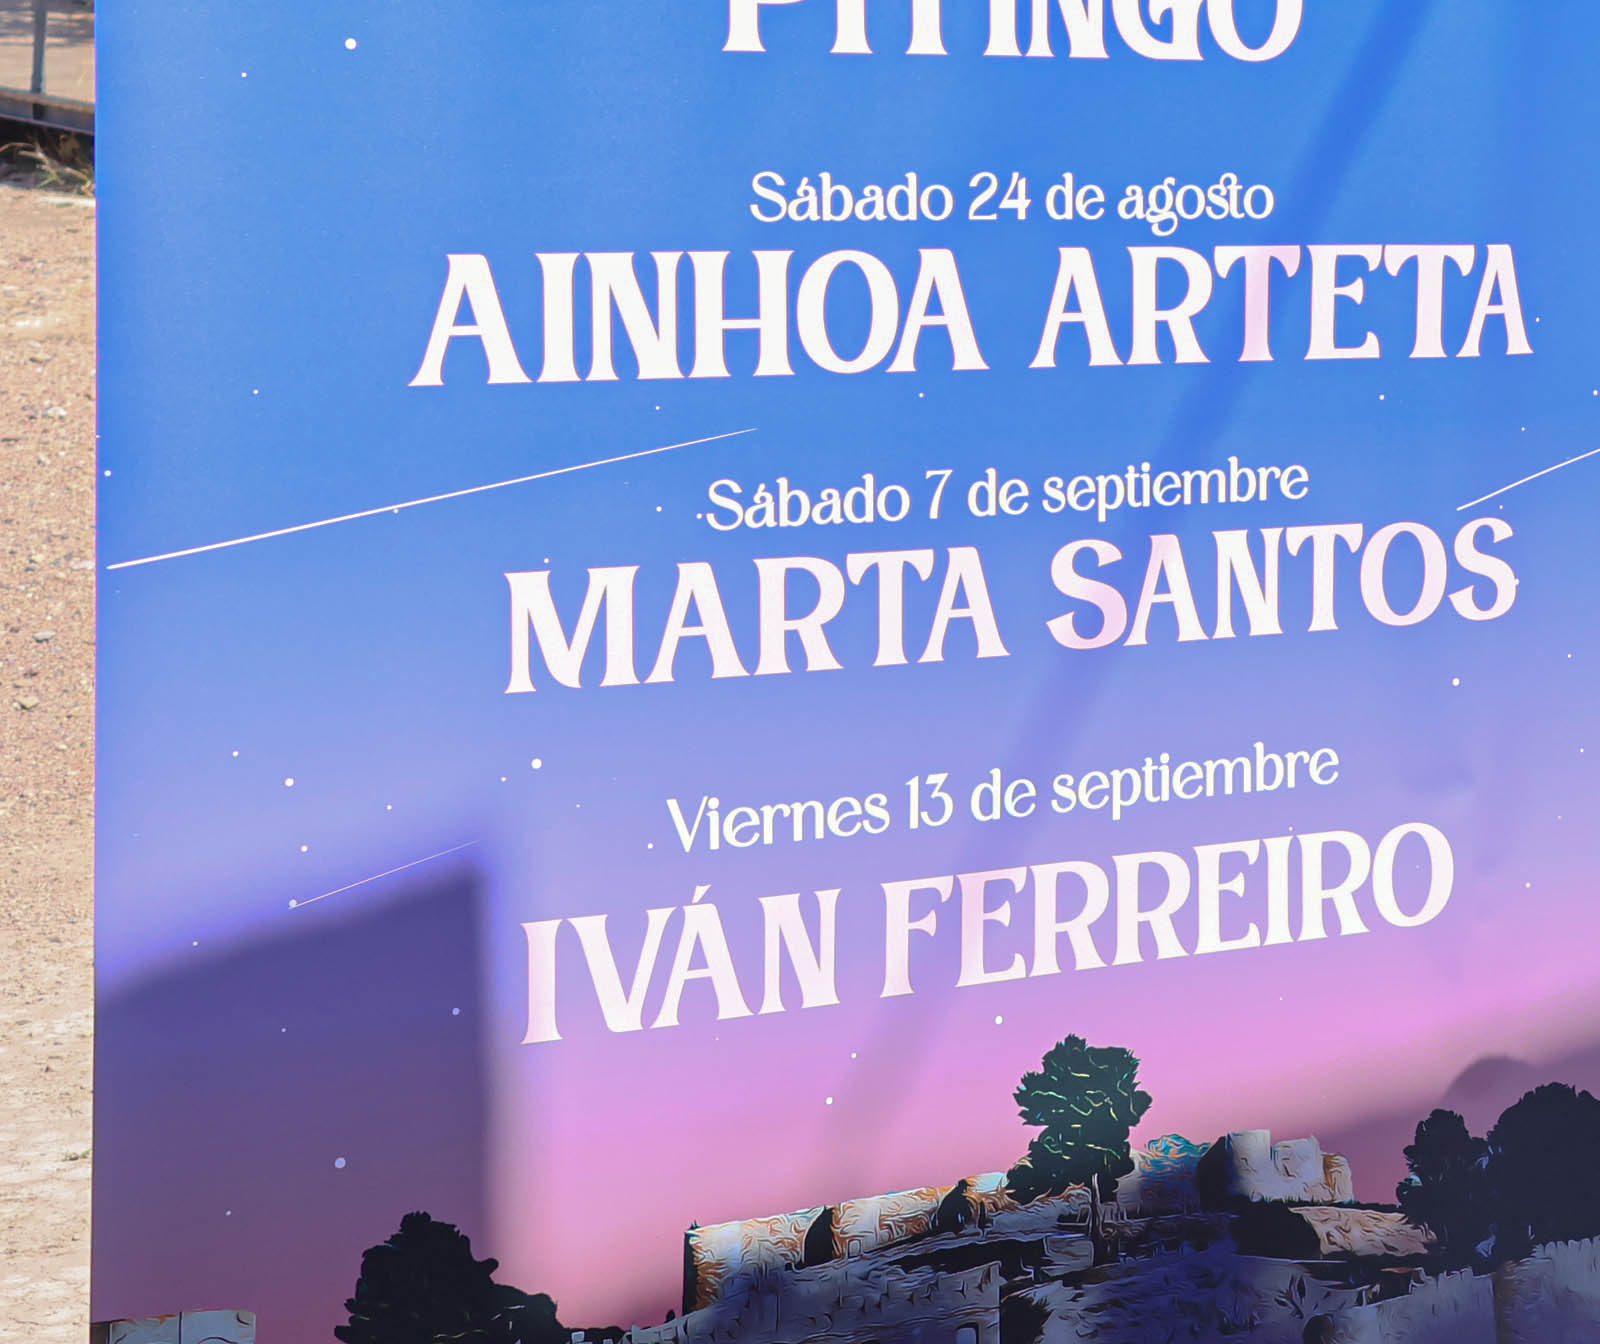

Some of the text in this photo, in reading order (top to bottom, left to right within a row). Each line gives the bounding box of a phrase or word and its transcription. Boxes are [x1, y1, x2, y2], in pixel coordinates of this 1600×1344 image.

[750, 172, 1273, 236] Sábado 24 de agosto
[409, 244, 1533, 386] AINHOA ARTETA
[707, 456, 1309, 530] Sábado 7 de septiembre
[505, 517, 1516, 693] MARTA SANTOS
[667, 742, 1339, 852] Viernes 13 de septiembre
[521, 822, 1454, 1044] IVÁN FERREIRO
